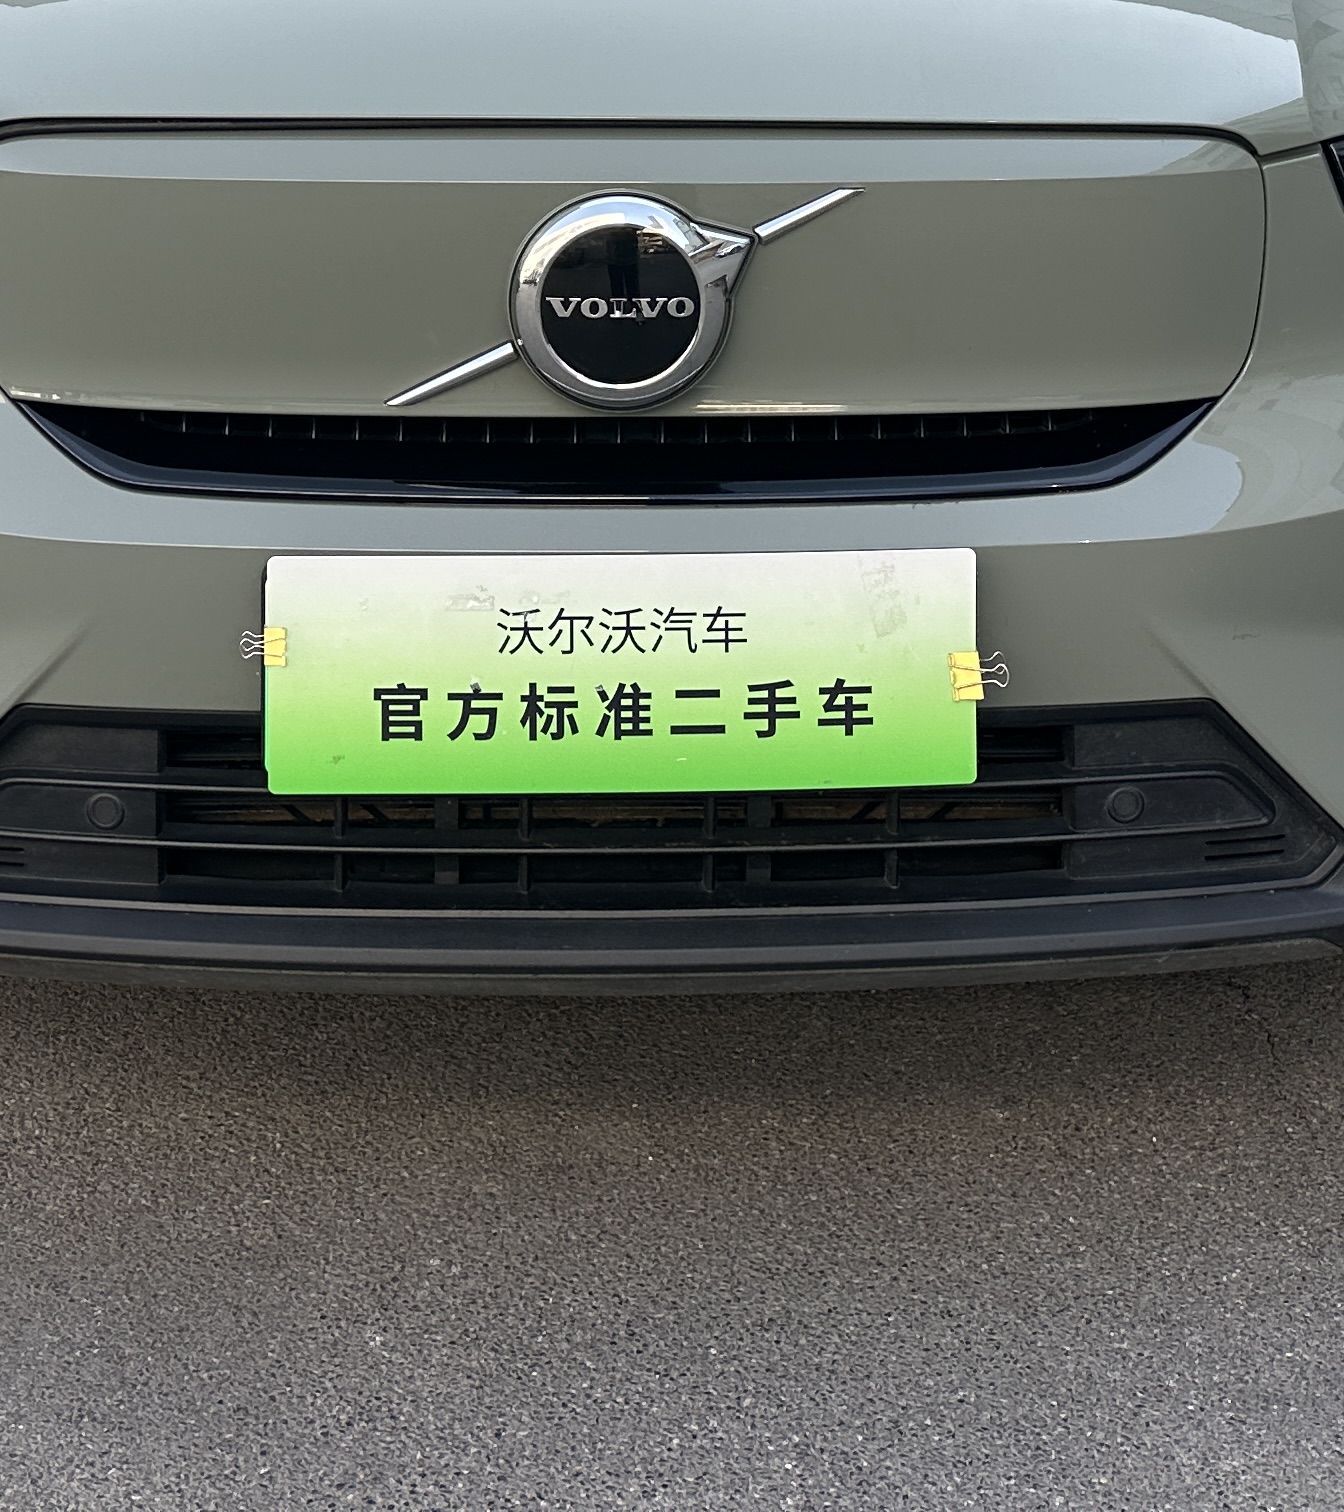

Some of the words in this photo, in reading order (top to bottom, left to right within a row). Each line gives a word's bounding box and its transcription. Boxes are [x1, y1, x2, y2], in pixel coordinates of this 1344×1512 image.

[545, 296, 696, 319] VOLVO
[496, 605, 749, 655] 沃尔沃汽车
[372, 678, 876, 742] 官方标准二手车
